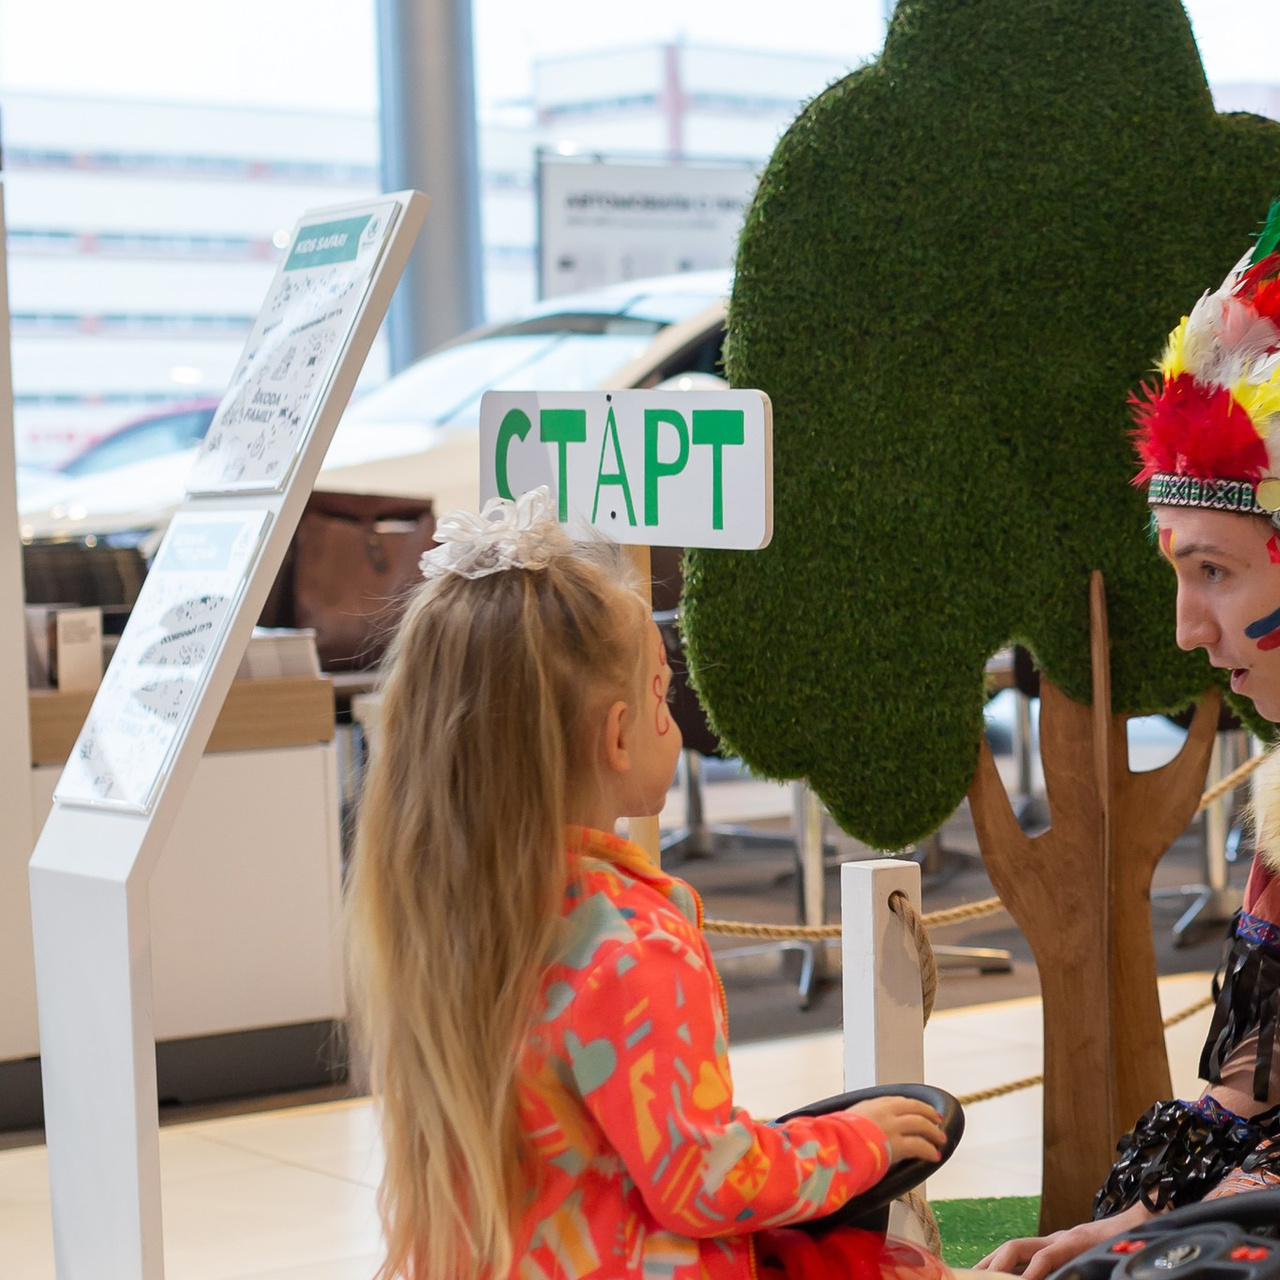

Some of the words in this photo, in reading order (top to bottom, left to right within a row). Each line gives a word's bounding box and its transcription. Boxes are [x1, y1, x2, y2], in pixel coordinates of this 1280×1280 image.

[295, 239, 317, 254] KIDS
[316, 233, 349, 251] SAFARI
[244, 408, 275, 423] FAMILY
[495, 406, 744, 529] СТАРТ
